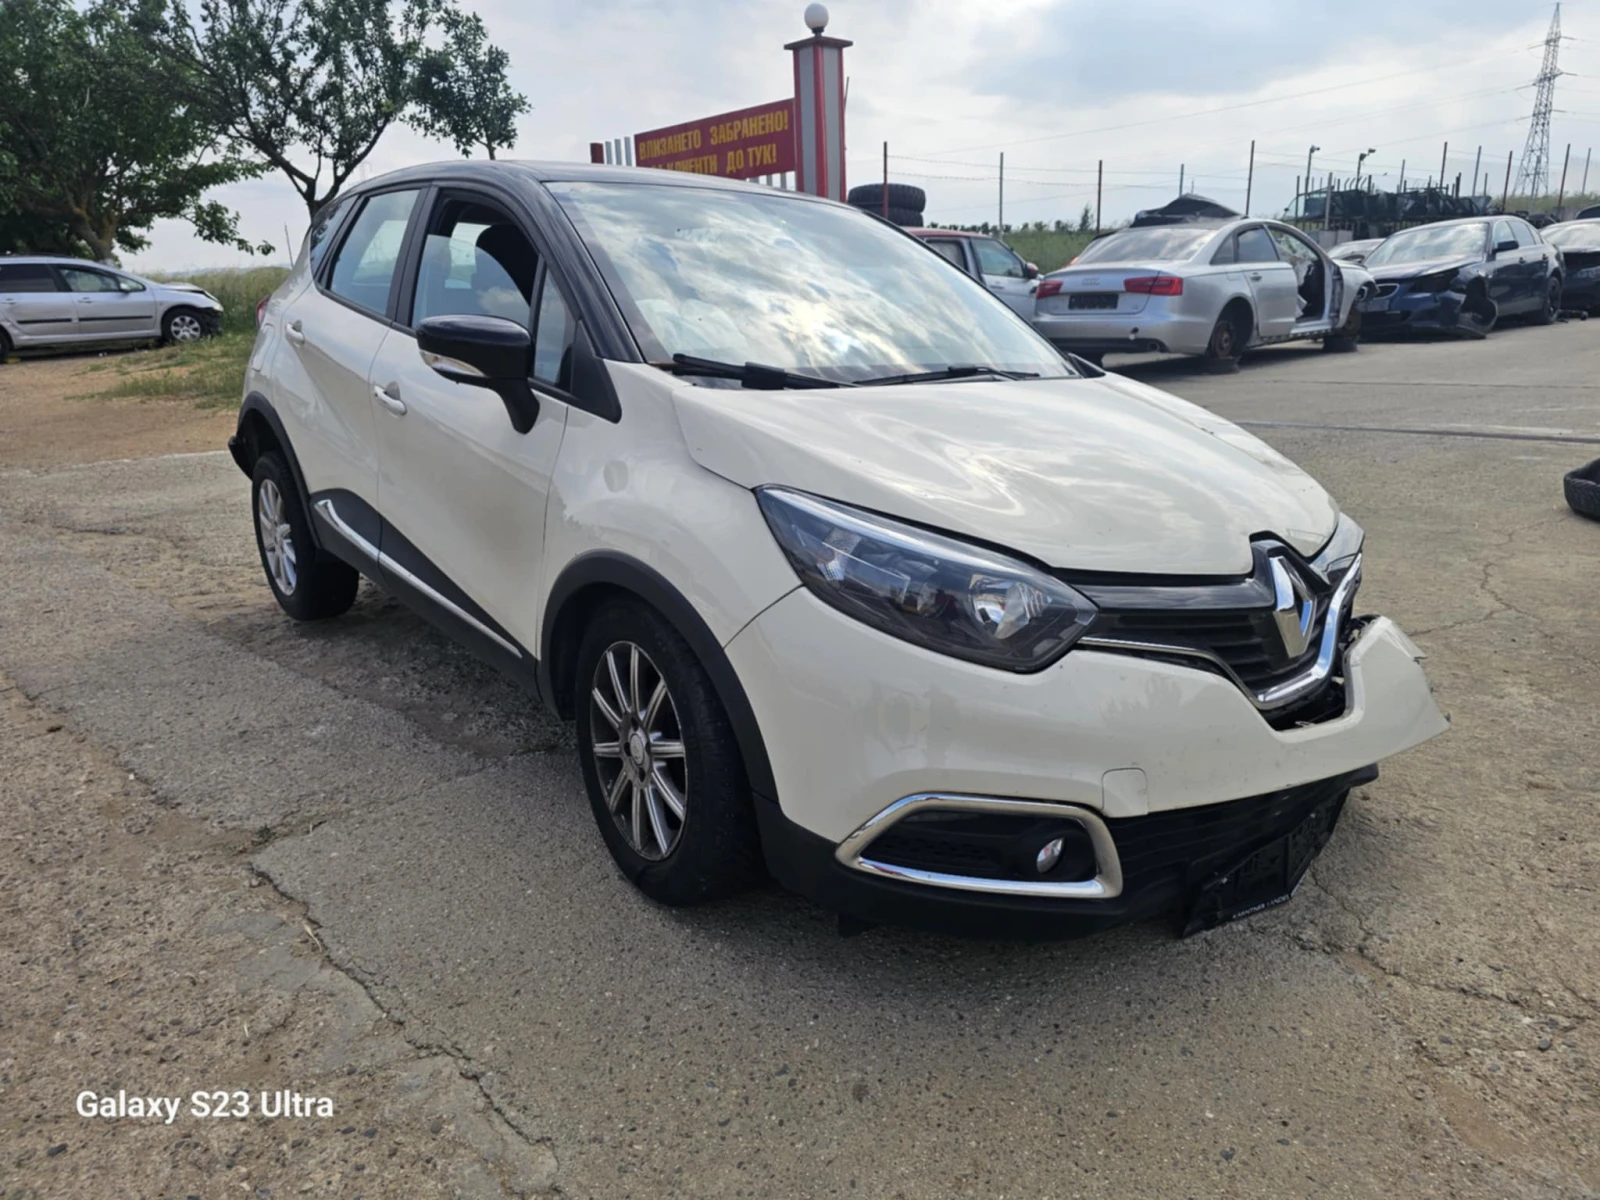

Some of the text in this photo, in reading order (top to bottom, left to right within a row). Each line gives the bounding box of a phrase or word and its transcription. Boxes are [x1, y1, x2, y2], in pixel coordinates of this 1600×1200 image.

[640, 110, 788, 159] ВЛИЗАНЕТО ЗАБРАНЕНО!
[726, 150, 744, 174] ДО
[748, 143, 777, 167] ТУК!
